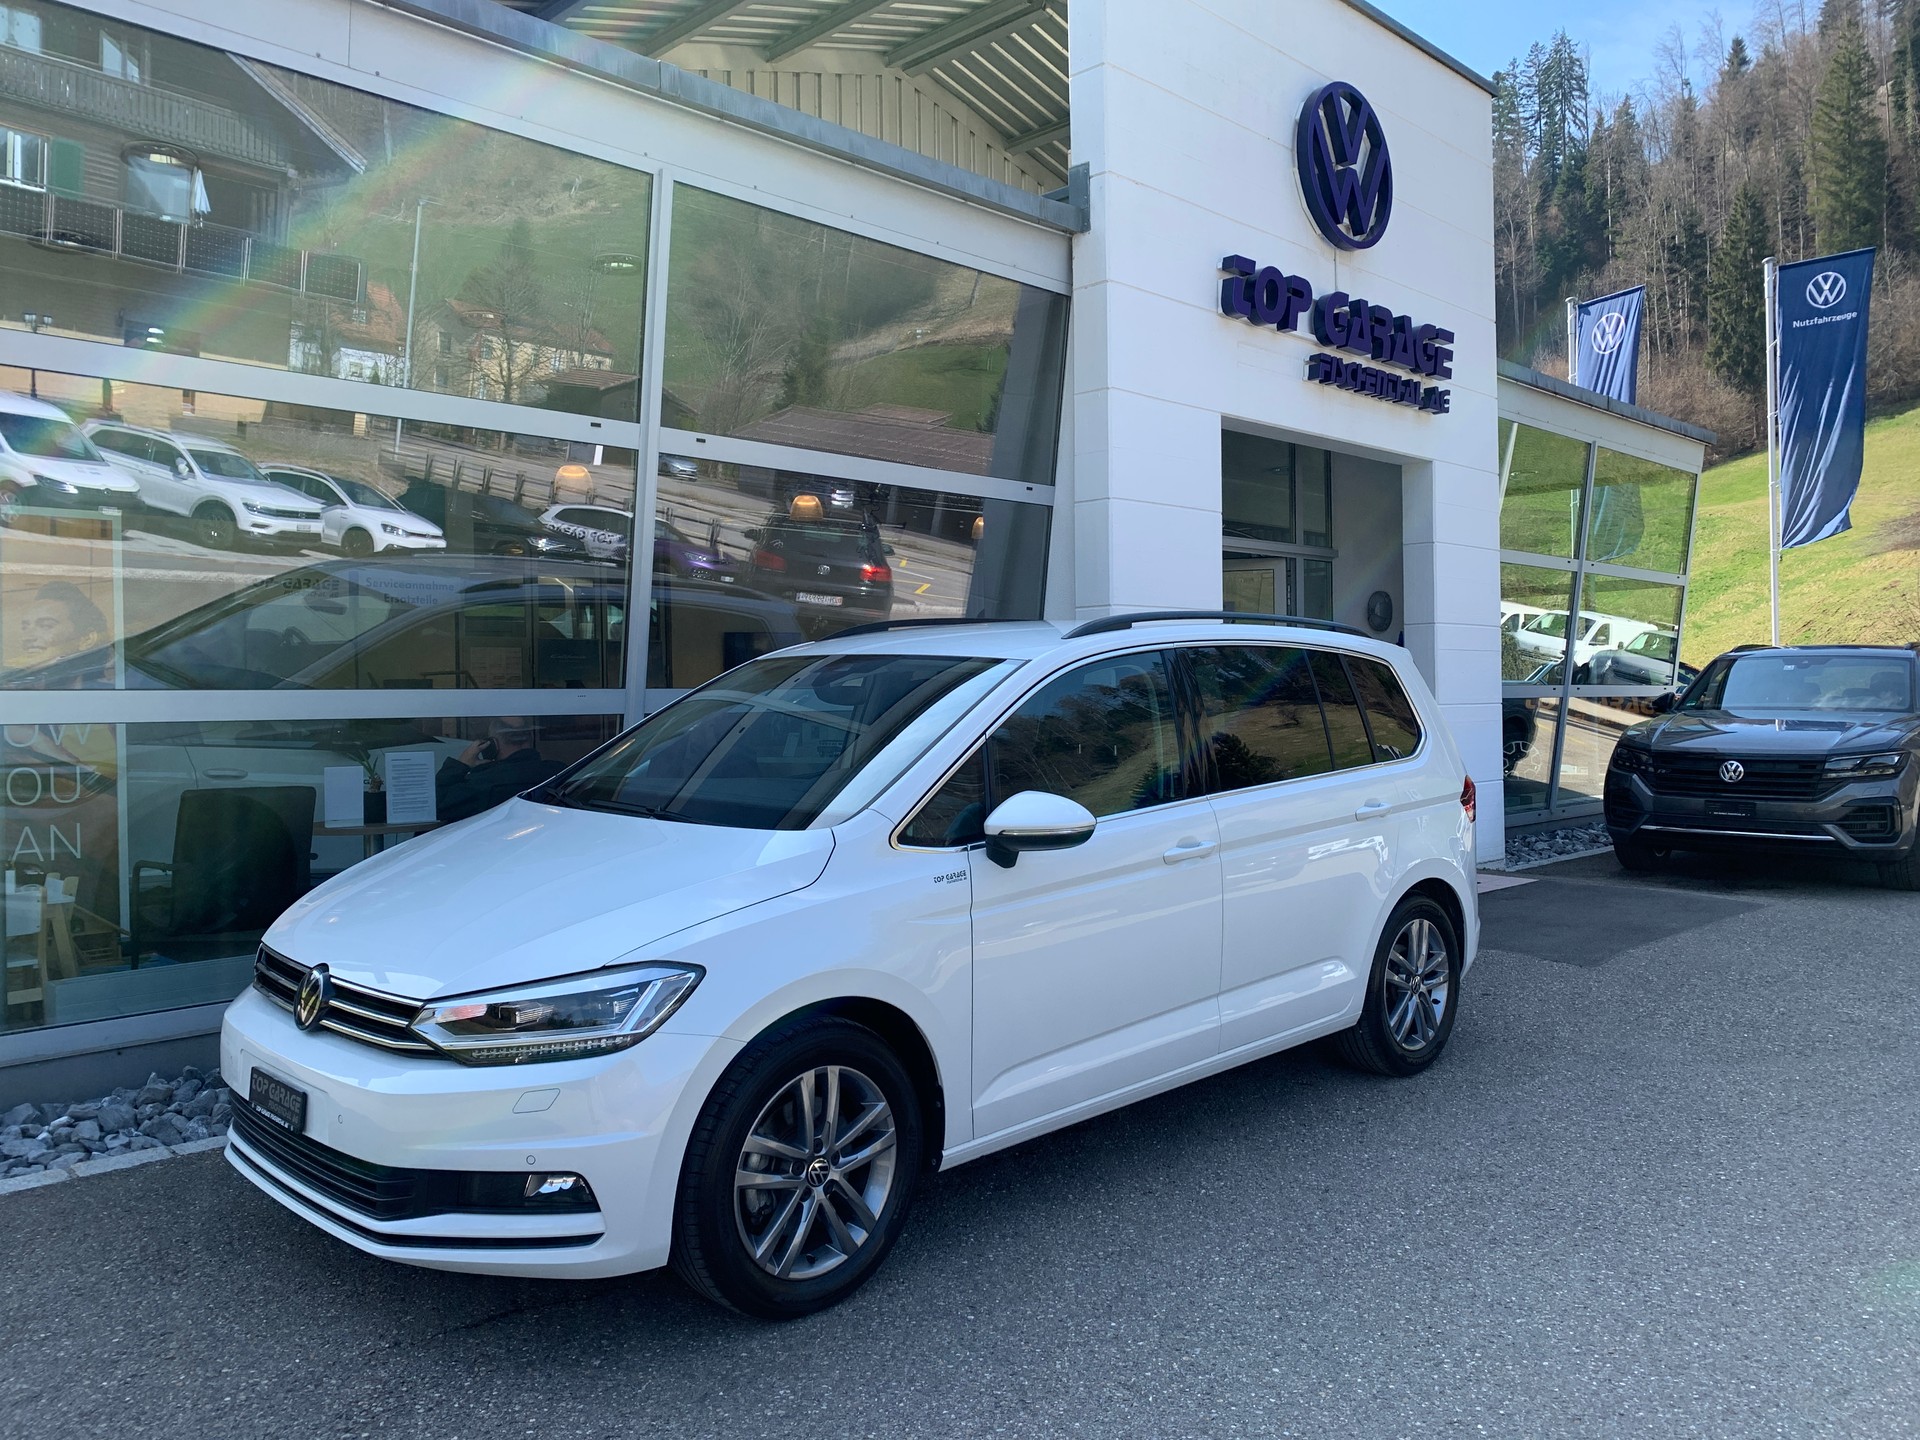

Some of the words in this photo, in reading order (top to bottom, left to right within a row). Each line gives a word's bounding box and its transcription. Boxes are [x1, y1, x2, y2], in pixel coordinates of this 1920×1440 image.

[1221, 254, 1313, 333] TOP
[1312, 291, 1454, 380] GARAGE
[1792, 311, 1858, 329] Nutzfahrzeuge
[1308, 352, 1424, 408] FISCHENTHAL
[282, 577, 340, 590] GARAGE
[365, 577, 456, 592] Serviceannahme
[383, 593, 439, 605] Ersatzteile
[3, 725, 92, 748] OW
[5, 766, 82, 806] OU
[11, 823, 82, 862] AN
[933, 875, 945, 884] TOP
[945, 869, 967, 881] GARAGE
[252, 1073, 269, 1095] TOP
[268, 1083, 302, 1113] GARAGE
